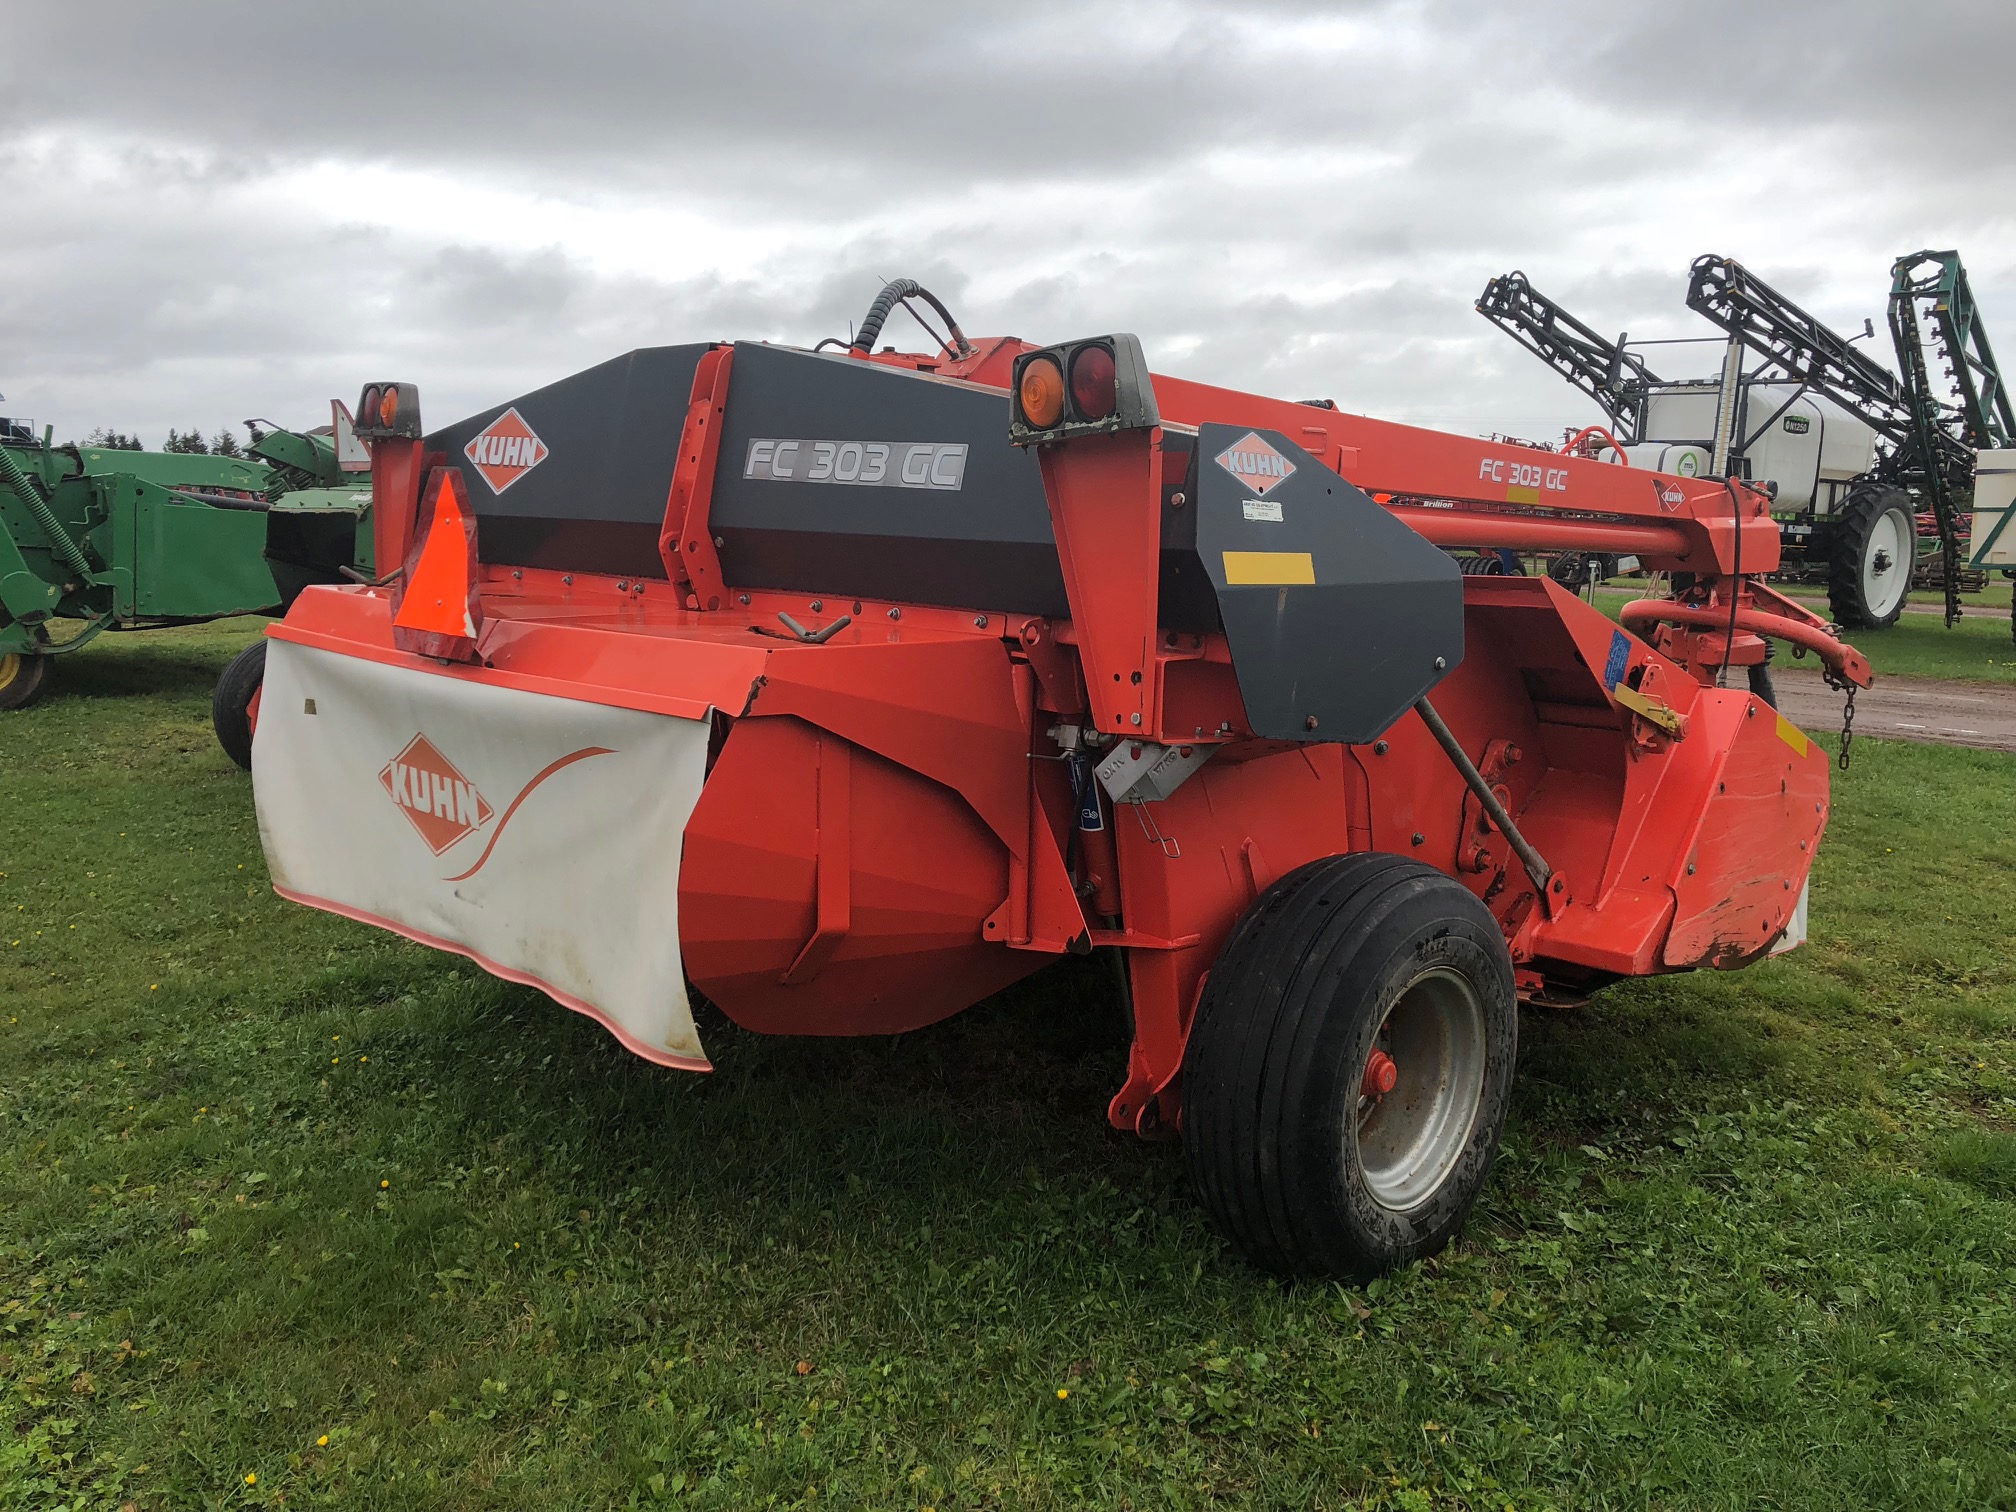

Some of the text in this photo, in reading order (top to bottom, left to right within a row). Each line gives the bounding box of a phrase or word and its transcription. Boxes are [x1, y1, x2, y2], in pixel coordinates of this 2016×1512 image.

[473, 434, 538, 467] KUHN
[746, 440, 964, 486] FC 303 GC
[1226, 449, 1287, 478] KUHN
[1479, 458, 1568, 491] FC 303 GC
[1422, 500, 1454, 509] Brillion
[1664, 491, 1683, 503] KUHN
[389, 759, 480, 831] KUHN
